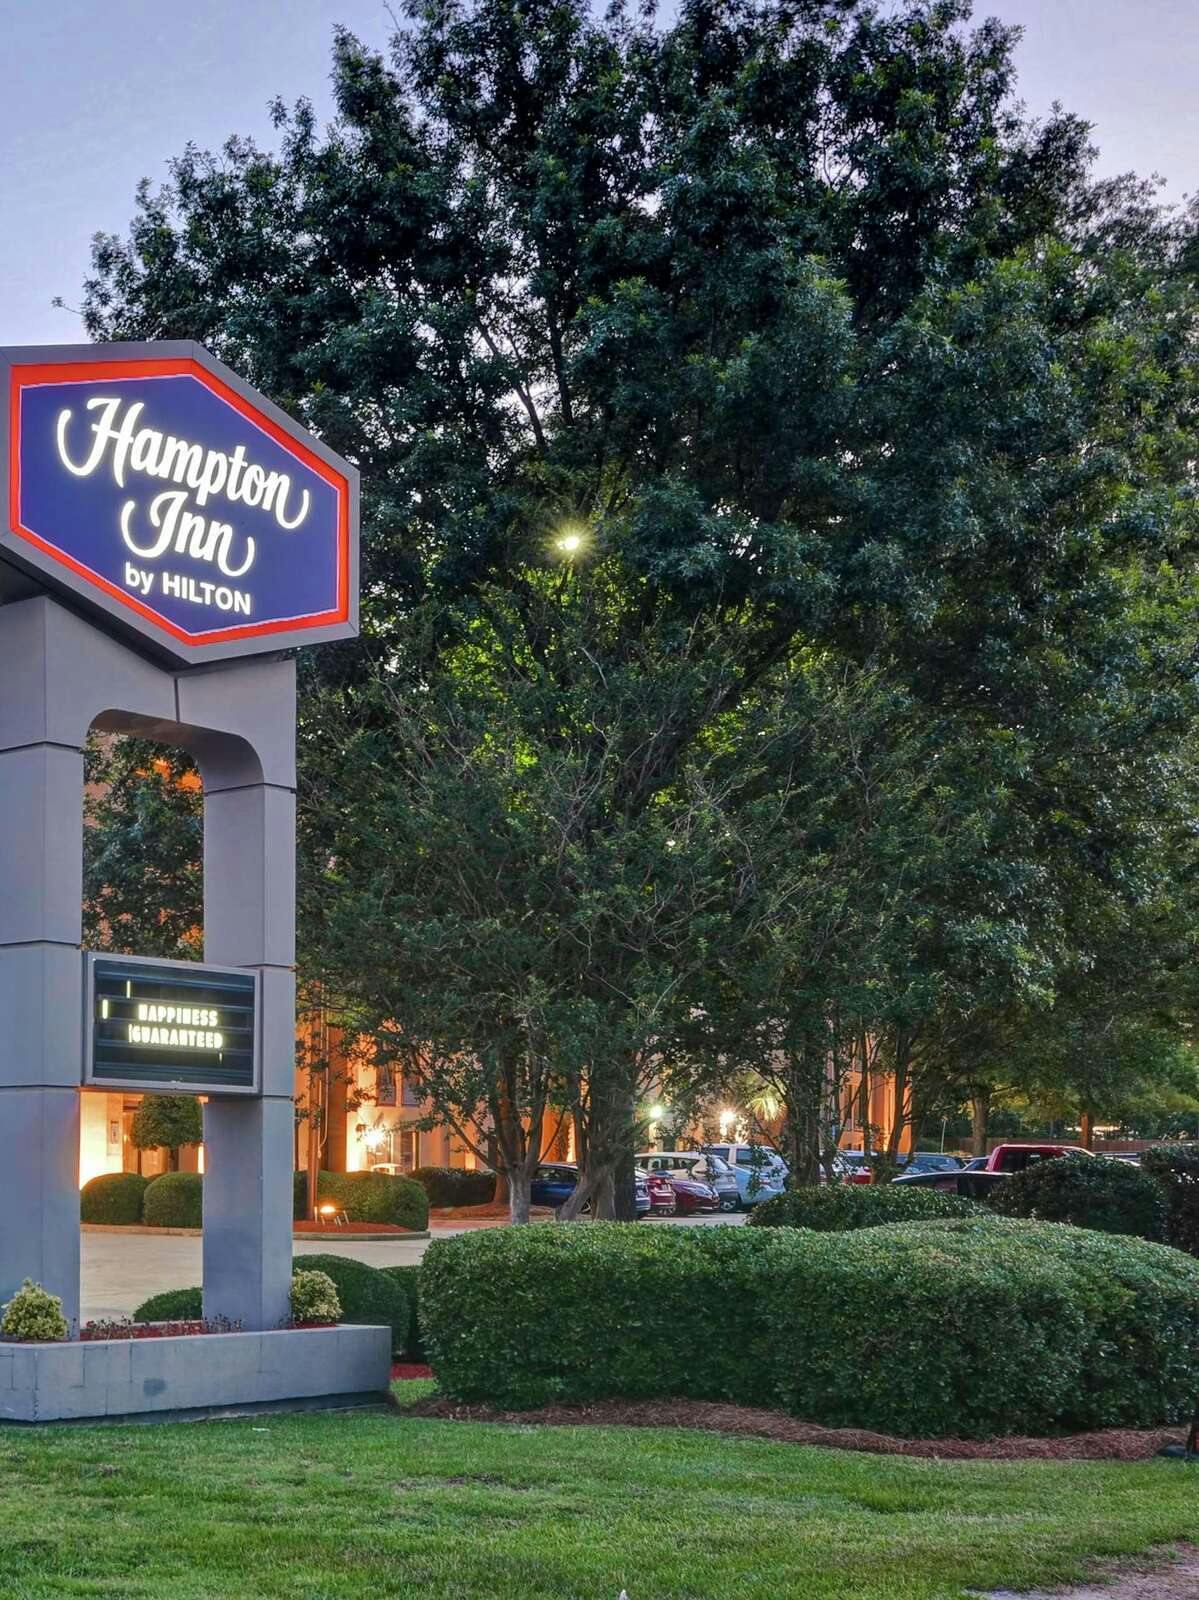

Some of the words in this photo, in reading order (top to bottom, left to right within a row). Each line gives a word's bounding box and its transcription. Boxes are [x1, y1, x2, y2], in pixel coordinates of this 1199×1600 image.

[57, 398, 310, 530] Hampton
[120, 491, 255, 577] Inn
[125, 562, 154, 594] by
[163, 572, 251, 615] HILTON
[131, 1025, 224, 1049] GUARANTEED
[138, 1004, 218, 1027] HAPPINESS
